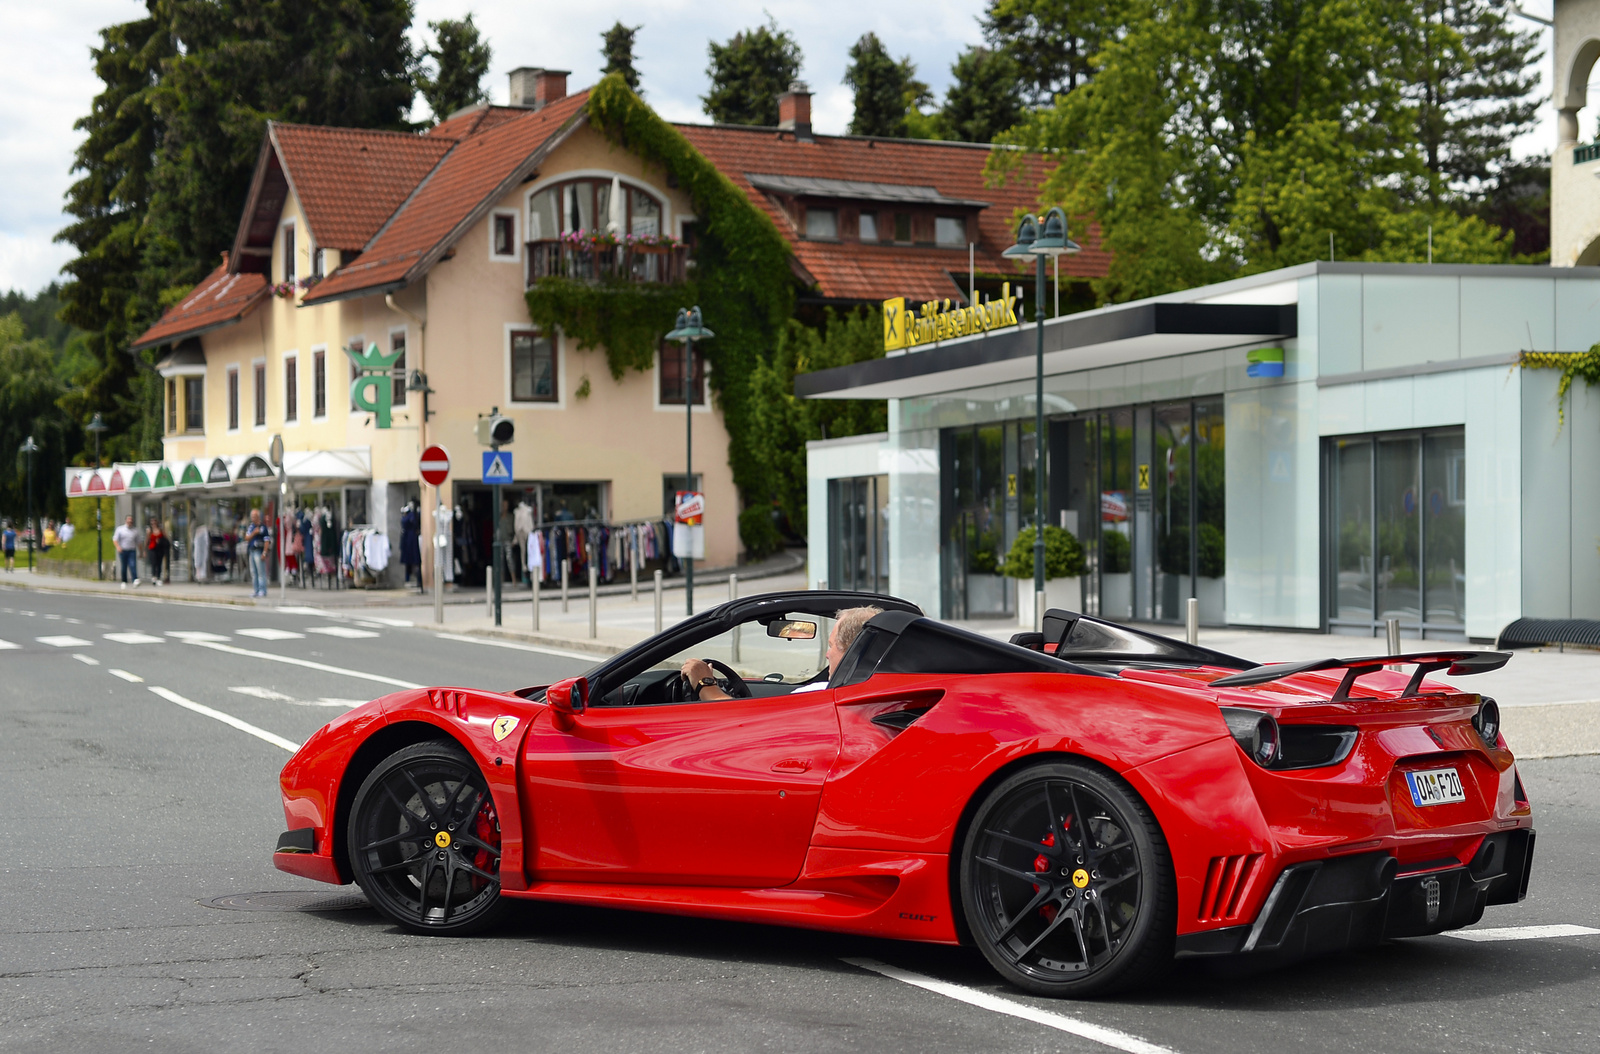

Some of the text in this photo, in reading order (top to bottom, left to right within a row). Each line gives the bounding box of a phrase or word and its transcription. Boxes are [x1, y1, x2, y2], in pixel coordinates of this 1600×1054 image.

[904, 281, 1018, 346] Raiffeisenbank
[1416, 774, 1435, 801] OA
[899, 912, 938, 922] CULT
